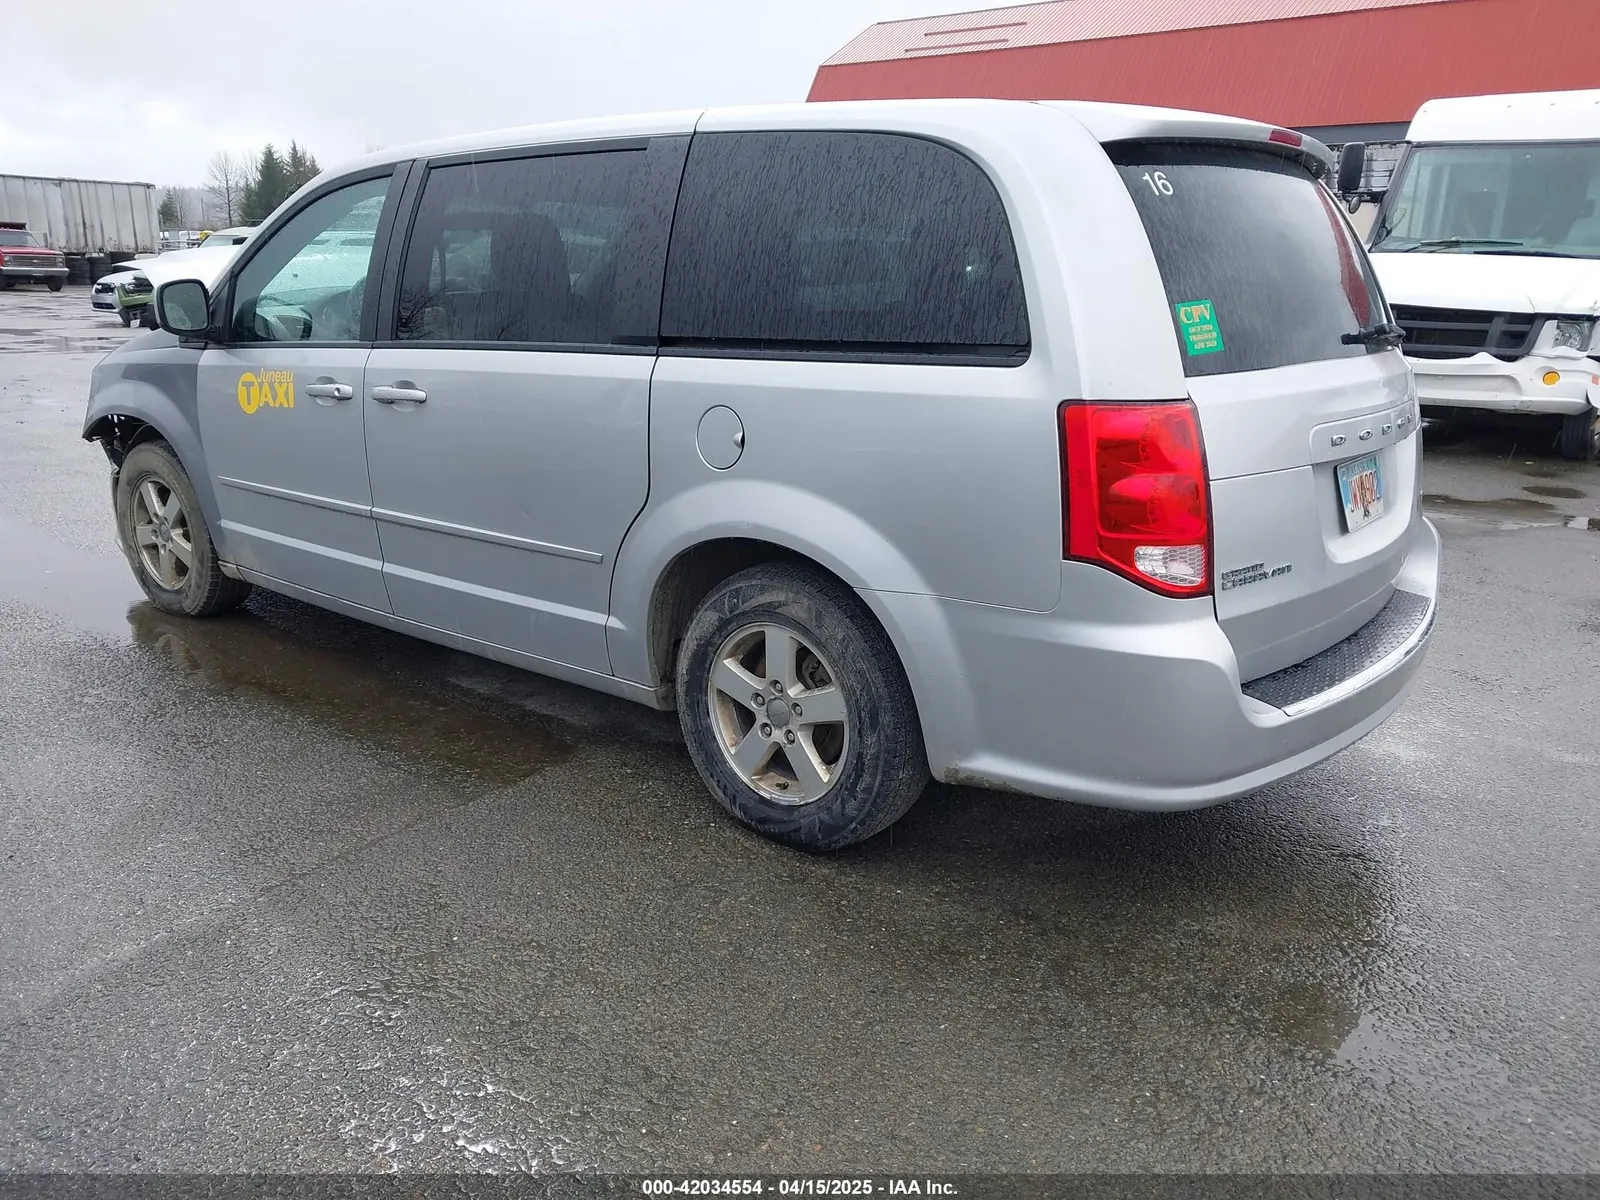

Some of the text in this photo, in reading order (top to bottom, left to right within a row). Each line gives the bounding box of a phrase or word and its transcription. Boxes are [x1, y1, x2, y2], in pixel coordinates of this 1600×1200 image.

[1142, 171, 1174, 196] 16
[1179, 303, 1211, 324] CPV
[256, 367, 294, 383] Juneau
[239, 379, 295, 410] TAXI
